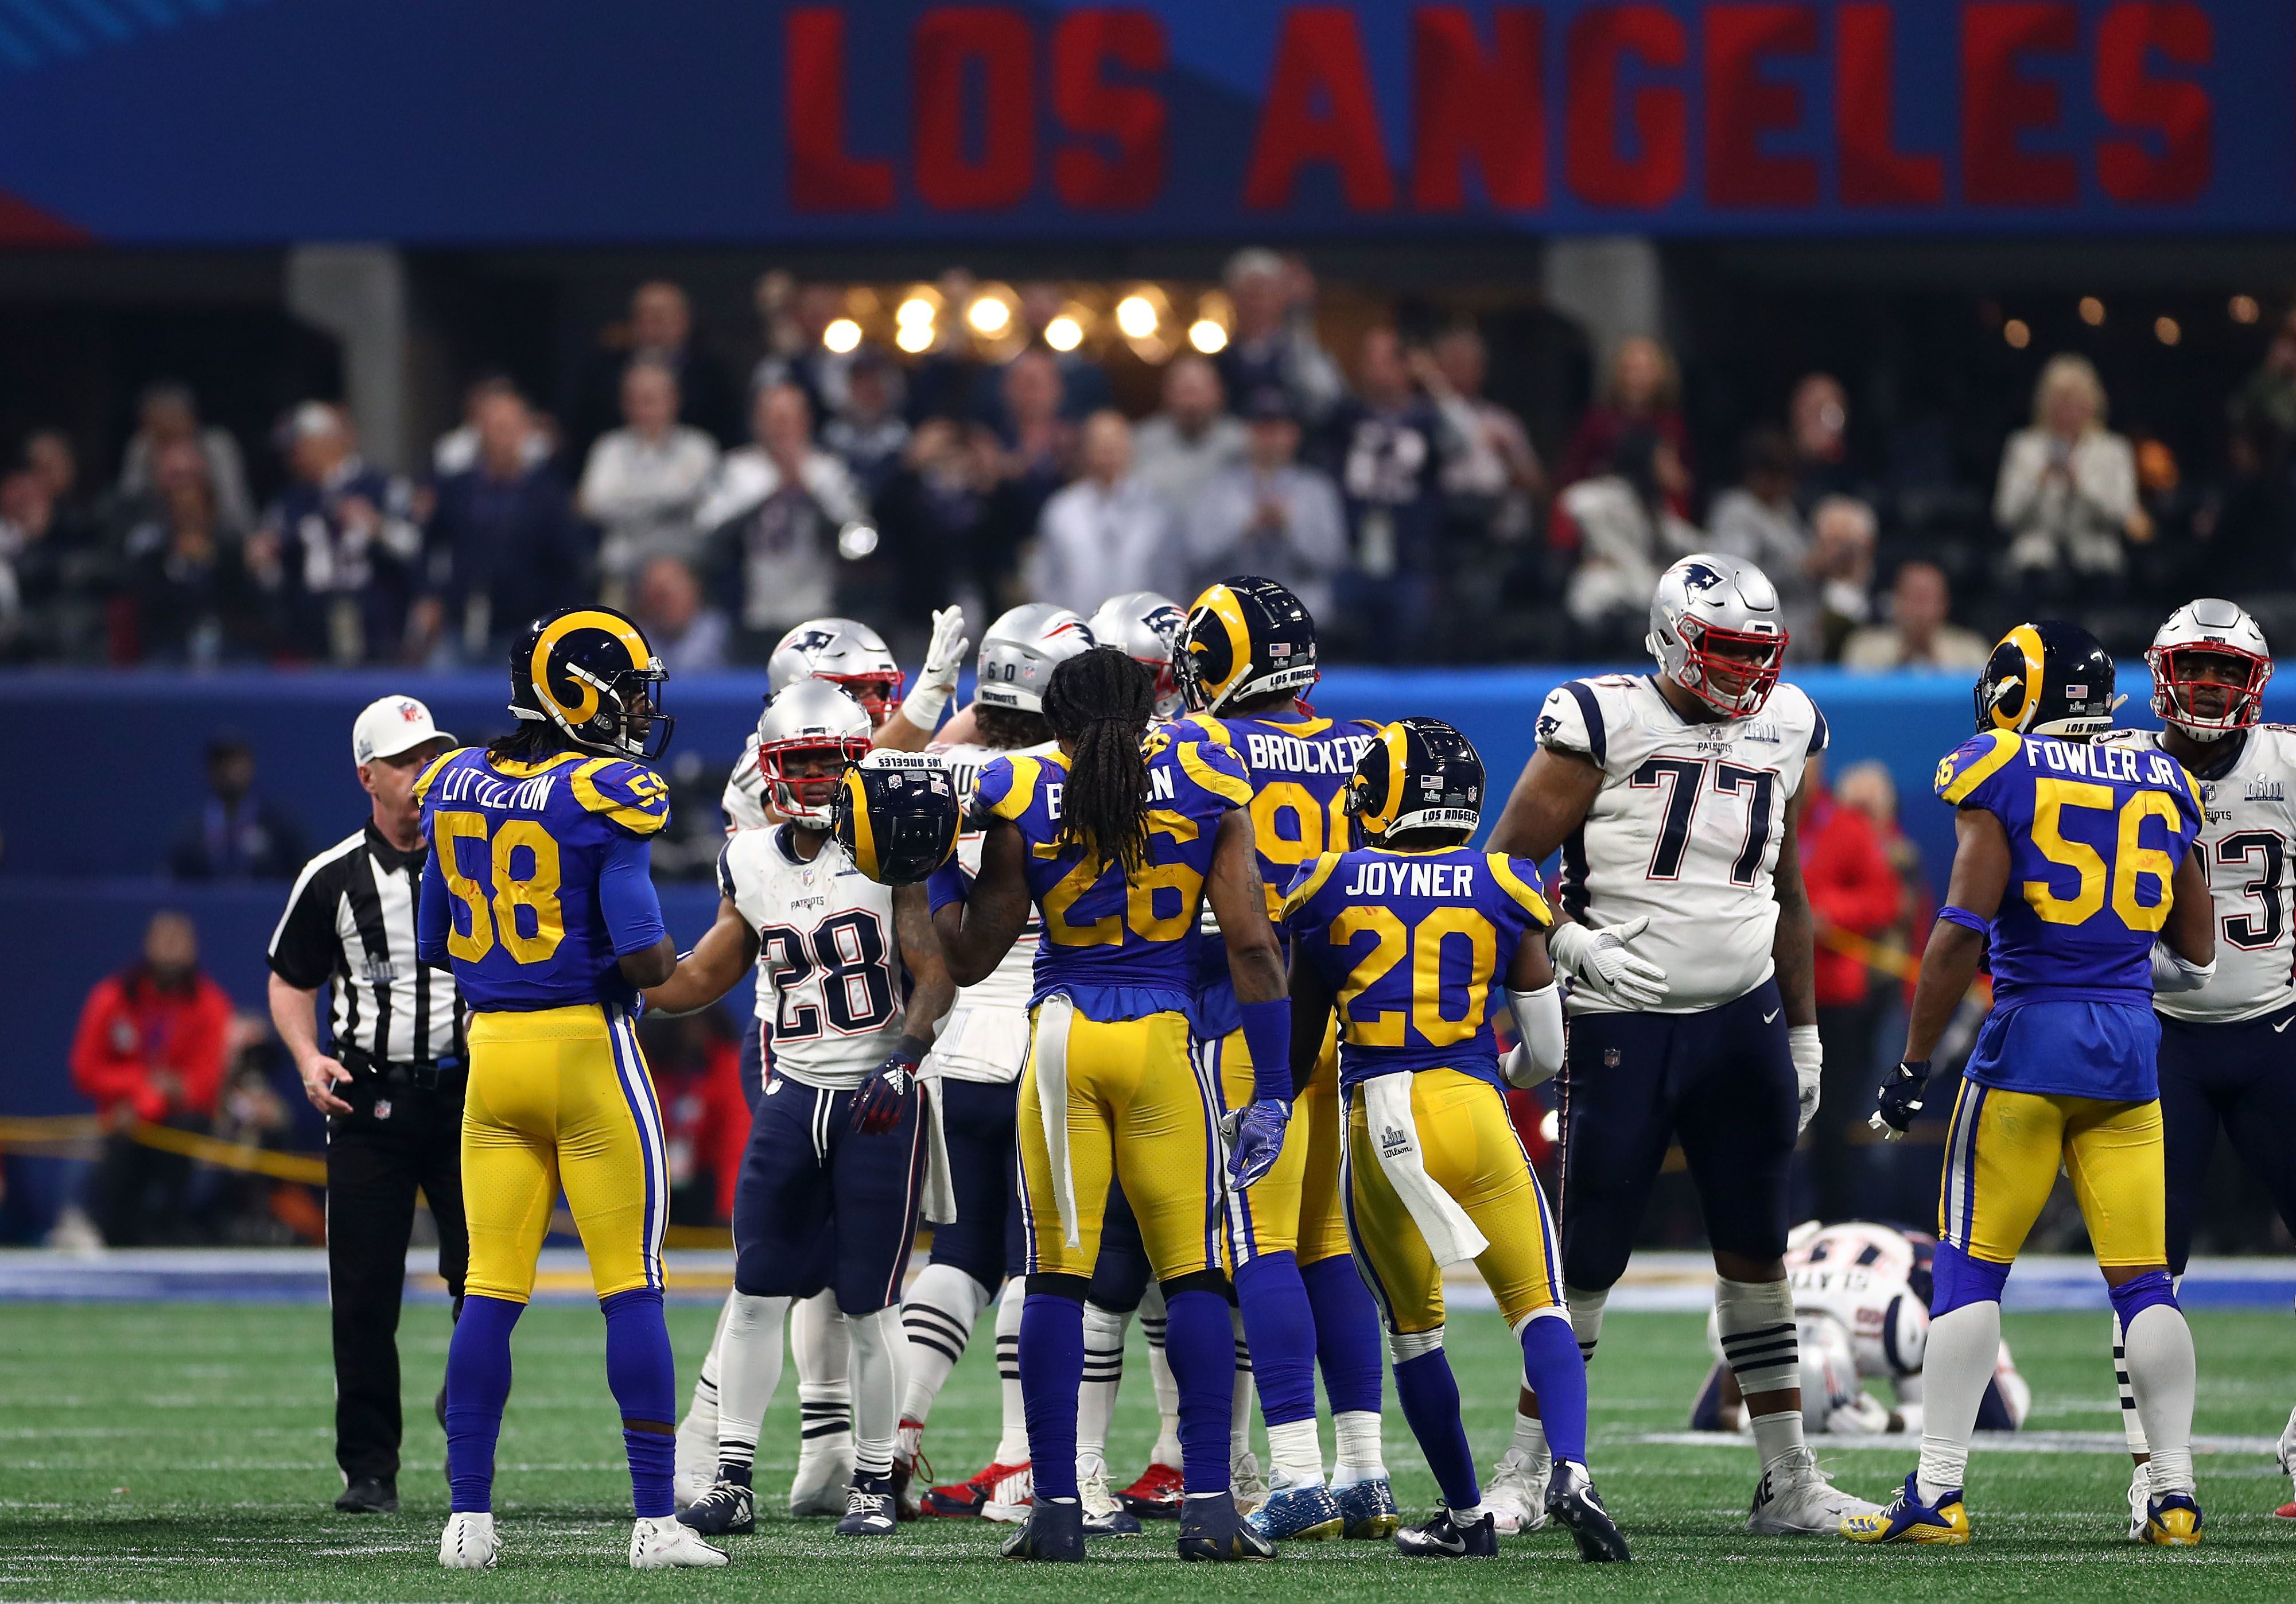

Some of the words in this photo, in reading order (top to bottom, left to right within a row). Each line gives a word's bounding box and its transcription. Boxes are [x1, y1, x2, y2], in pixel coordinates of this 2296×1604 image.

[785, 9, 1167, 211] LOS
[1242, 5, 2215, 211] ANGELES
[988, 662, 1015, 681] 60
[1271, 673, 1287, 686] LOS
[1290, 669, 1315, 681] ANGEL
[2065, 724, 2084, 732] LOS
[2085, 723, 2112, 733] ANGEL
[879, 758, 924, 767] ANGELES
[927, 758, 942, 767] LOS
[1697, 742, 1733, 753] PATRIOTS
[2024, 738, 2142, 783] FOWLER
[2146, 755, 2182, 791] JR.
[442, 767, 556, 811] LITTLETON
[1423, 810, 1442, 821] LOS
[1630, 755, 1779, 887] 77
[2205, 810, 2232, 821] RIOTS
[2023, 777, 2181, 933] 56
[434, 810, 565, 964] 58
[1033, 809, 1204, 946] 26
[1346, 861, 1474, 897] JOYNER
[2193, 829, 2287, 951] 3
[791, 896, 824, 911] PATRIOTS
[761, 907, 899, 1043] 28
[1329, 906, 1497, 1047] 20
[1384, 1147, 1410, 1158] Wilson
